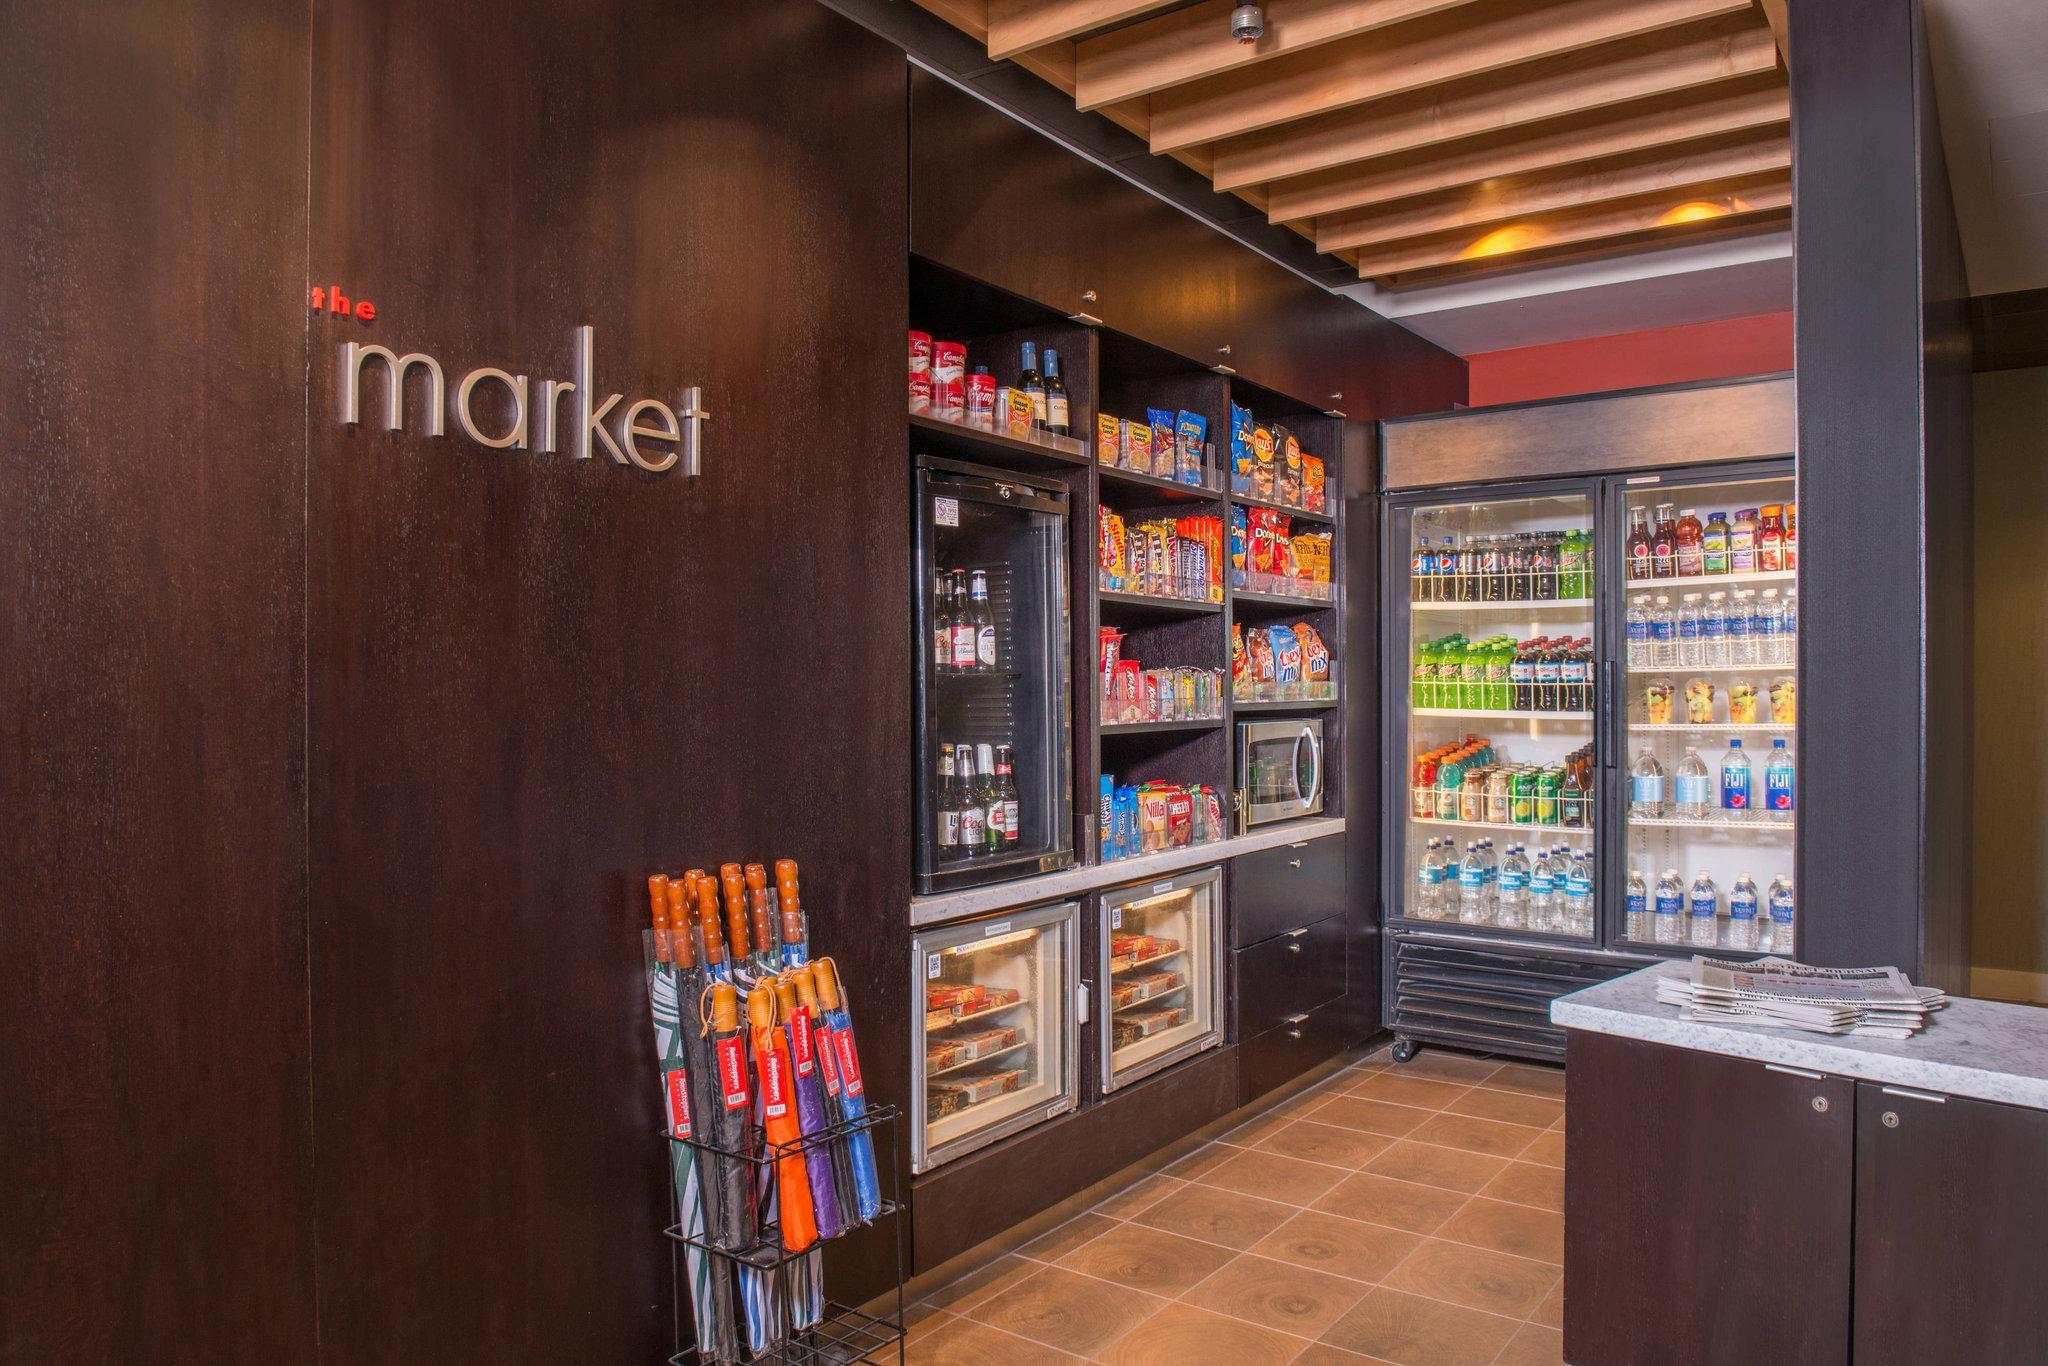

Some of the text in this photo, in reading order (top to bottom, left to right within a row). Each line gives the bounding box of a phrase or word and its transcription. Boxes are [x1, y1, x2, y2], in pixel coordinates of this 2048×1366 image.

[312, 286, 376, 320] the
[346, 325, 710, 476] market
[1725, 773, 1744, 787] FIJI
[1769, 773, 1789, 788] FIJI
[1145, 801, 1165, 818] Nilla
[961, 815, 985, 830] Coo
[1823, 967, 1878, 975] JOURNAL
